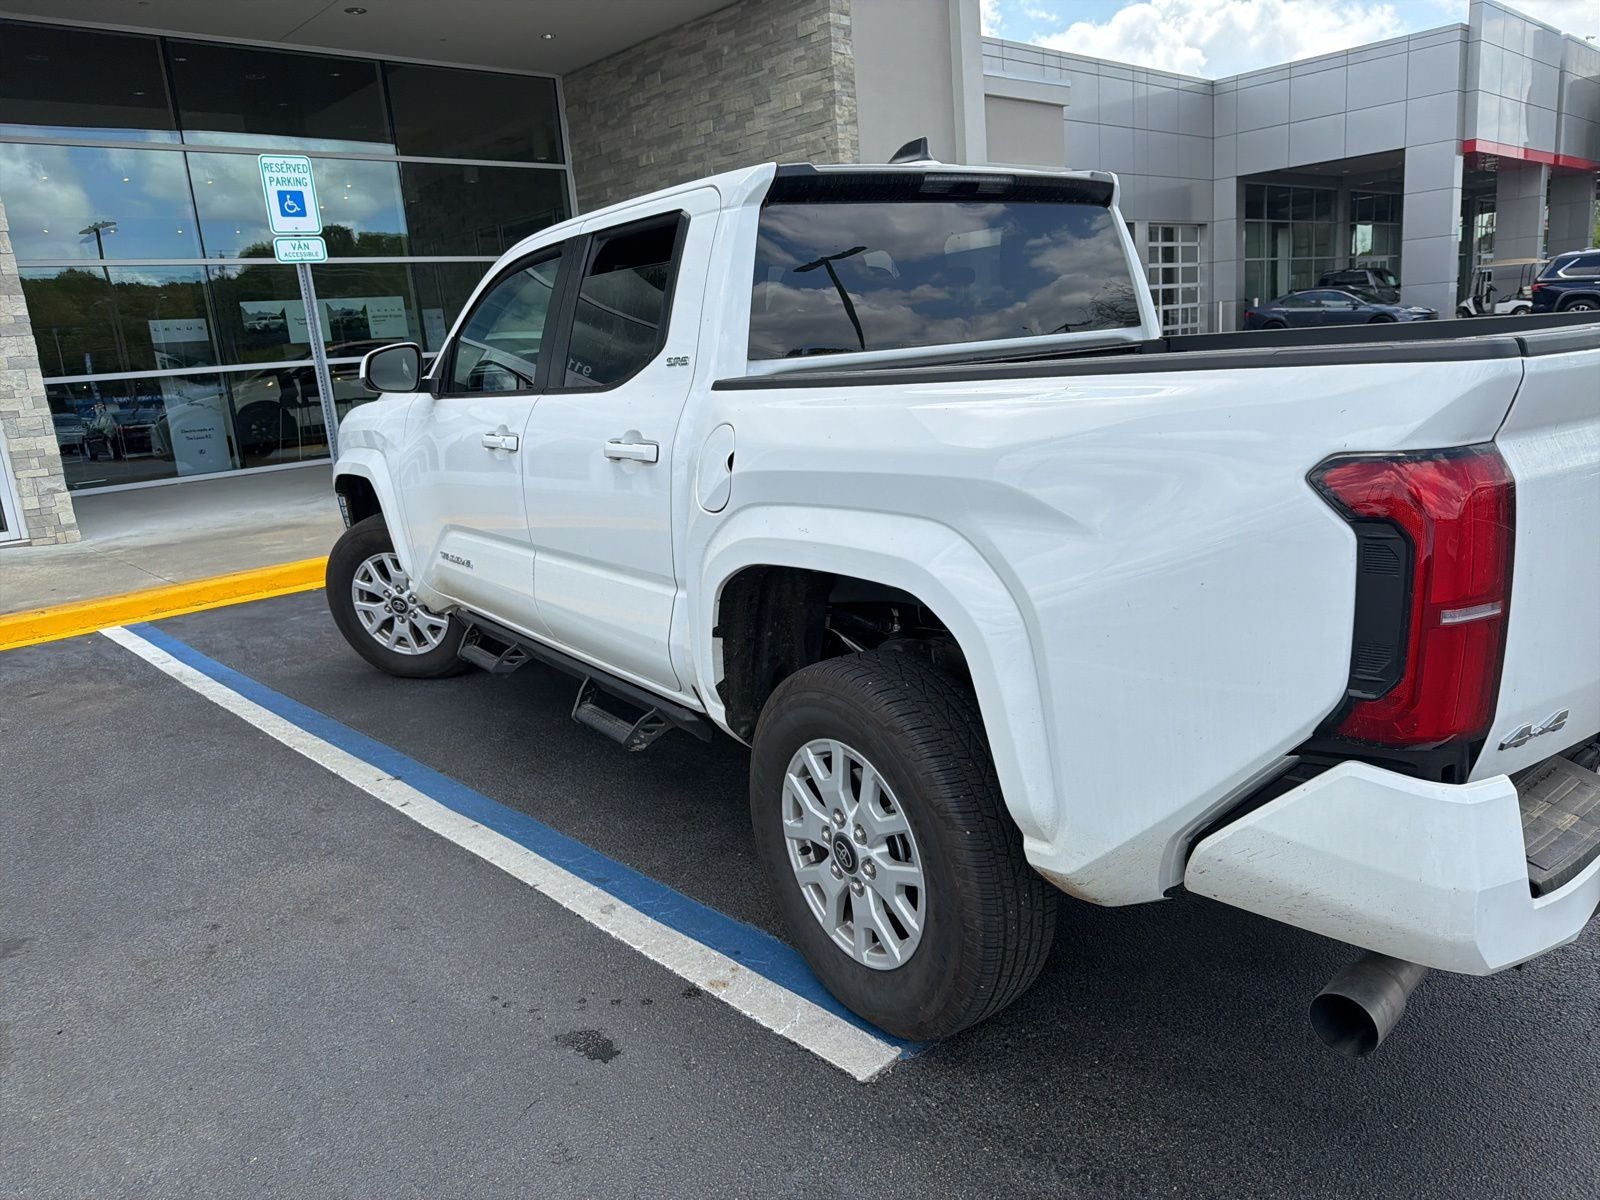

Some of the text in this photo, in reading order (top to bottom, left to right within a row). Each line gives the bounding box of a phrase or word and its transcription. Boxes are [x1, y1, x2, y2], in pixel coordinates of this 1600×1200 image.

[263, 162, 309, 174] RESERVED
[269, 176, 308, 187] PARKING
[290, 242, 310, 251] VAN
